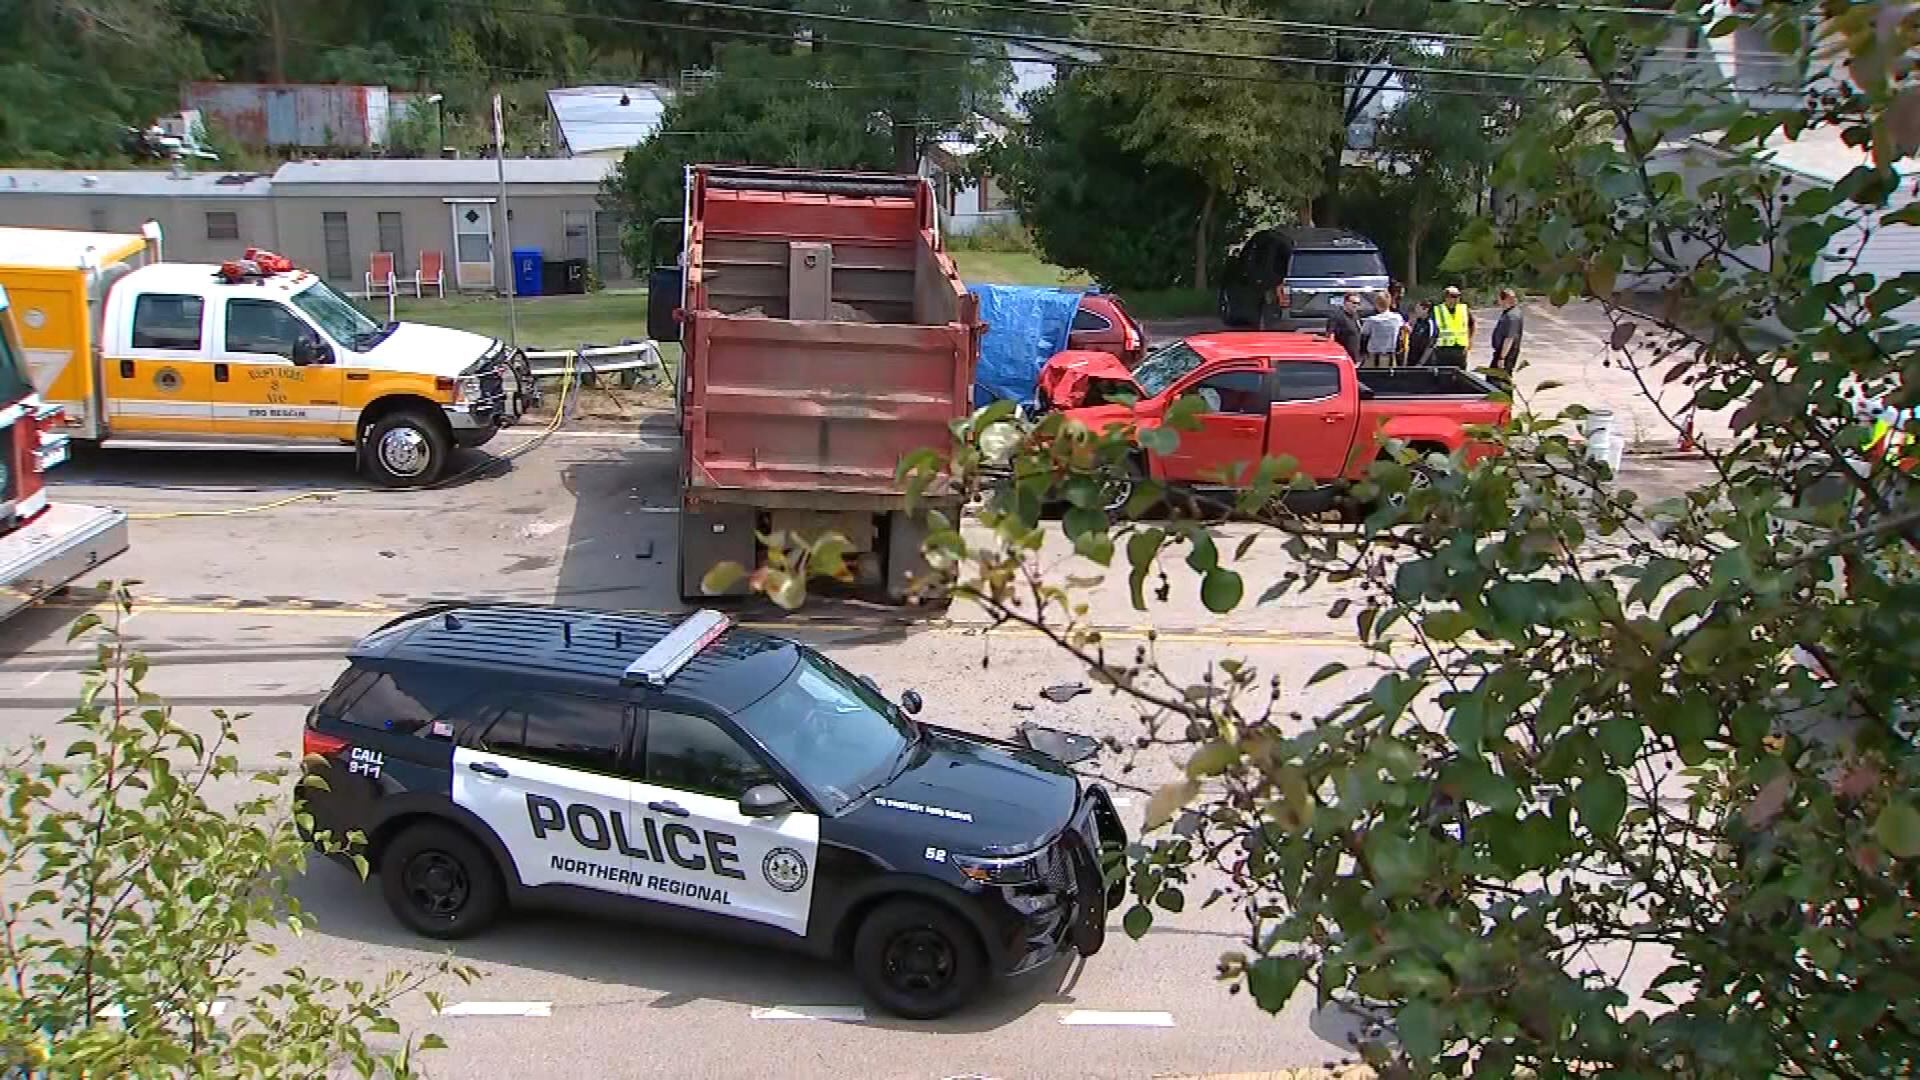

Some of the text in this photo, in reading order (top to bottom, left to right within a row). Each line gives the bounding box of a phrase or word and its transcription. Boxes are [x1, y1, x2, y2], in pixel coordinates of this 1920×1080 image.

[351, 747, 385, 765] CALL
[525, 792, 746, 880] POLICE
[925, 847, 947, 863] 52
[551, 855, 732, 905] NORTHERN REGIONAL
